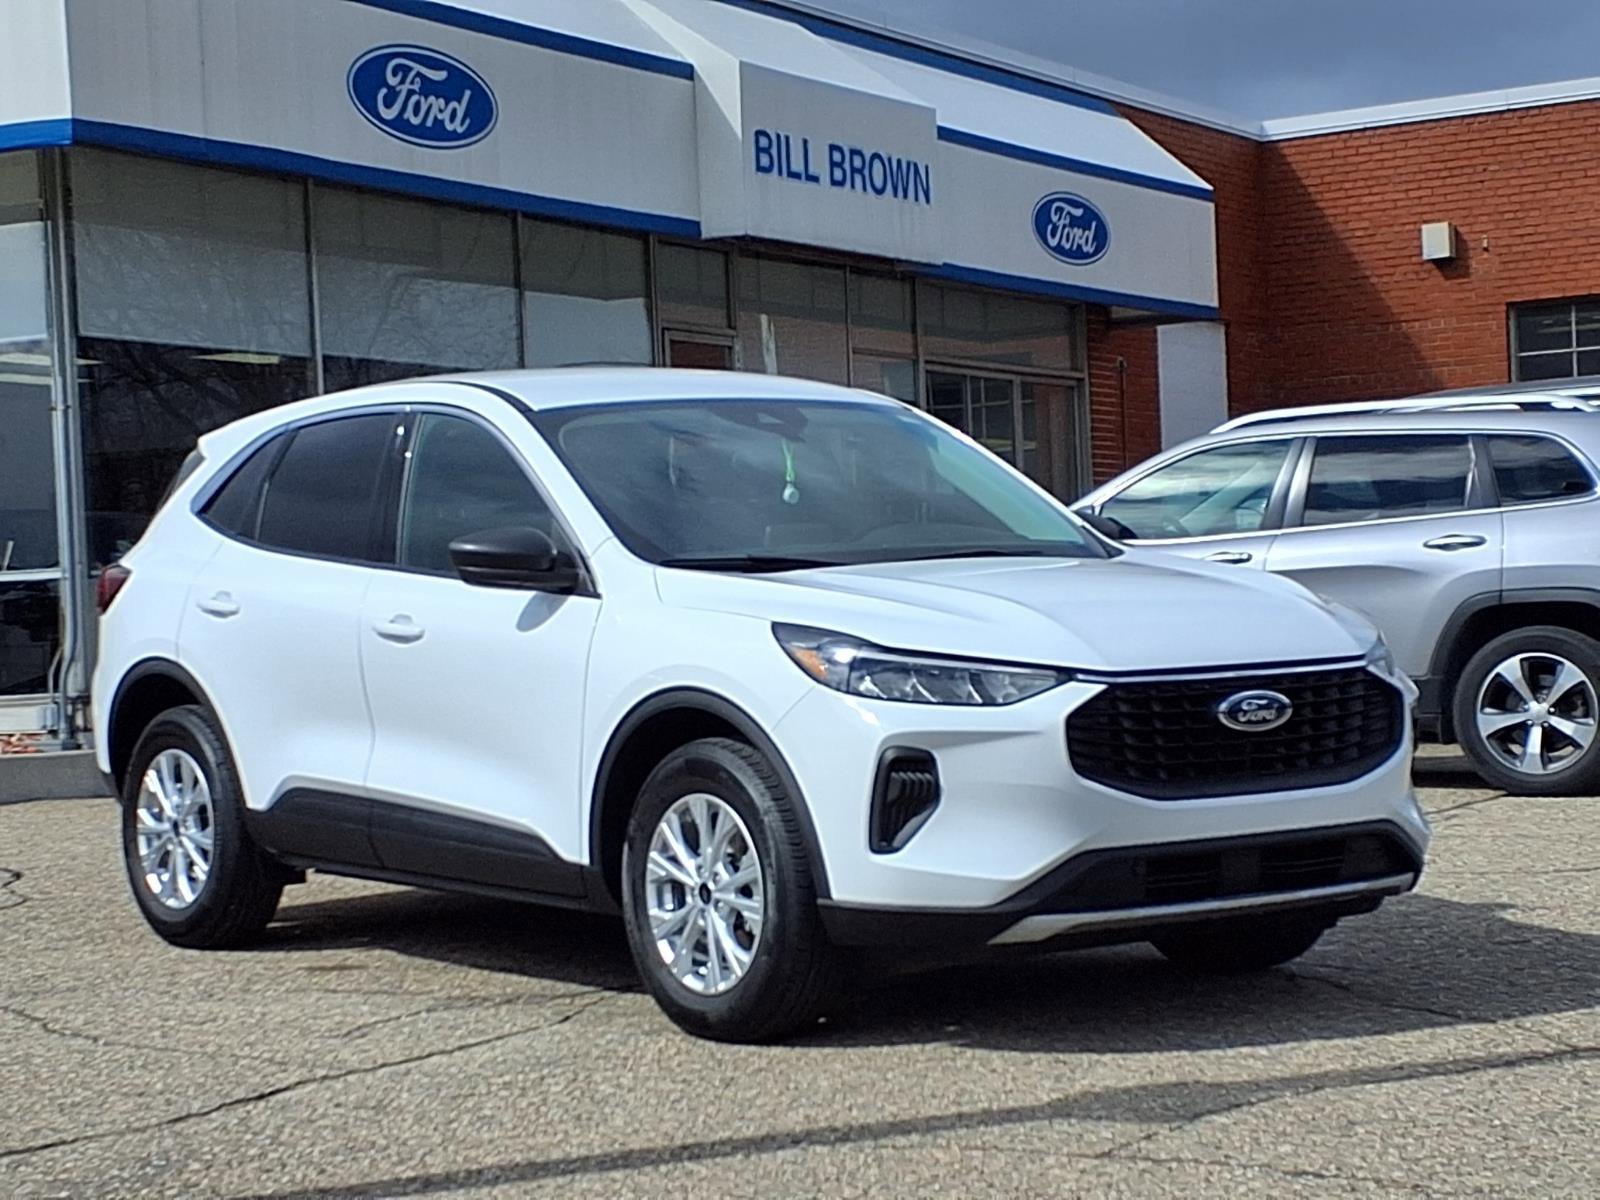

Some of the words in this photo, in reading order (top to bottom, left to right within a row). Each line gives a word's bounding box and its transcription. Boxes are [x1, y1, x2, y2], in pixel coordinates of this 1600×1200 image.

[377, 57, 472, 134] Ford
[754, 129, 820, 184] BILL
[828, 143, 931, 205] BROWN
[1046, 201, 1097, 254] Ford
[1237, 699, 1279, 722] Ford
